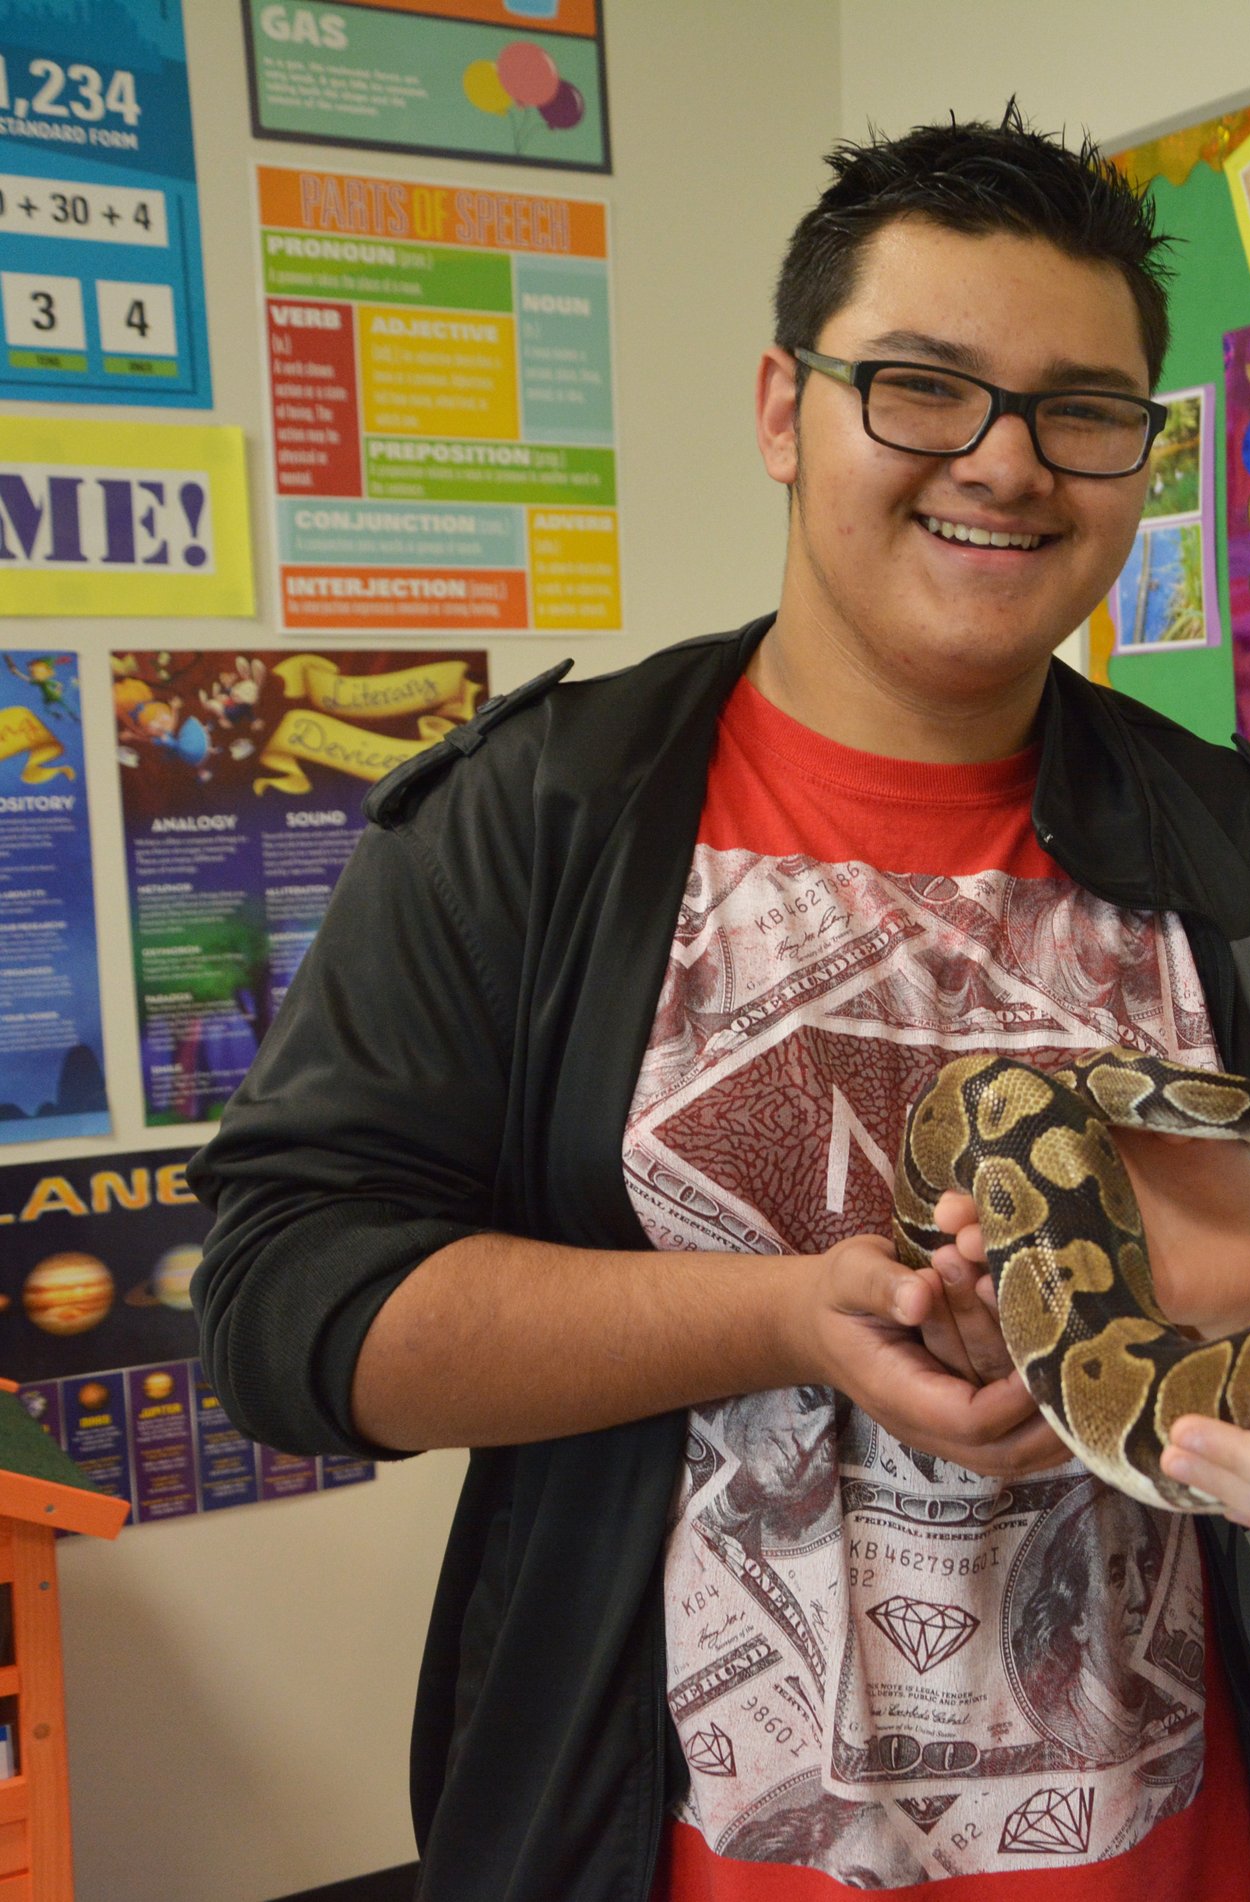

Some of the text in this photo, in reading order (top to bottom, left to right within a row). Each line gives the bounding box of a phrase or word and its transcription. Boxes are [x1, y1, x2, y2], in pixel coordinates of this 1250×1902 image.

[260, 5, 349, 50] GAS
[88, 127, 139, 150] FORM
[51, 193, 90, 226] 30
[133, 202, 152, 232] 4
[299, 174, 572, 251] PARTS OF SPEECH
[266, 234, 396, 266] PRONOUN
[30, 292, 57, 331] 3
[522, 292, 590, 317] NOUN
[125, 299, 150, 338] 4
[270, 305, 343, 331] VERB
[370, 315, 500, 344] ADJECTIVE
[368, 441, 530, 466] PREPOSITION
[294, 510, 476, 533] CONJUNCTION
[534, 514, 614, 532] ADVERB
[286, 576, 467, 599] INTERJECTION
[329, 674, 440, 712] Literary
[150, 811, 238, 833] ANALOGY
[286, 809, 347, 829] SOUND
[853, 1515, 923, 1539] FEDERAL
[908, 1692, 938, 1703] PUBLIC
[938, 1698, 957, 1706] AND
[915, 1685, 940, 1697] LEGAL
[950, 1822, 984, 1852] B2
